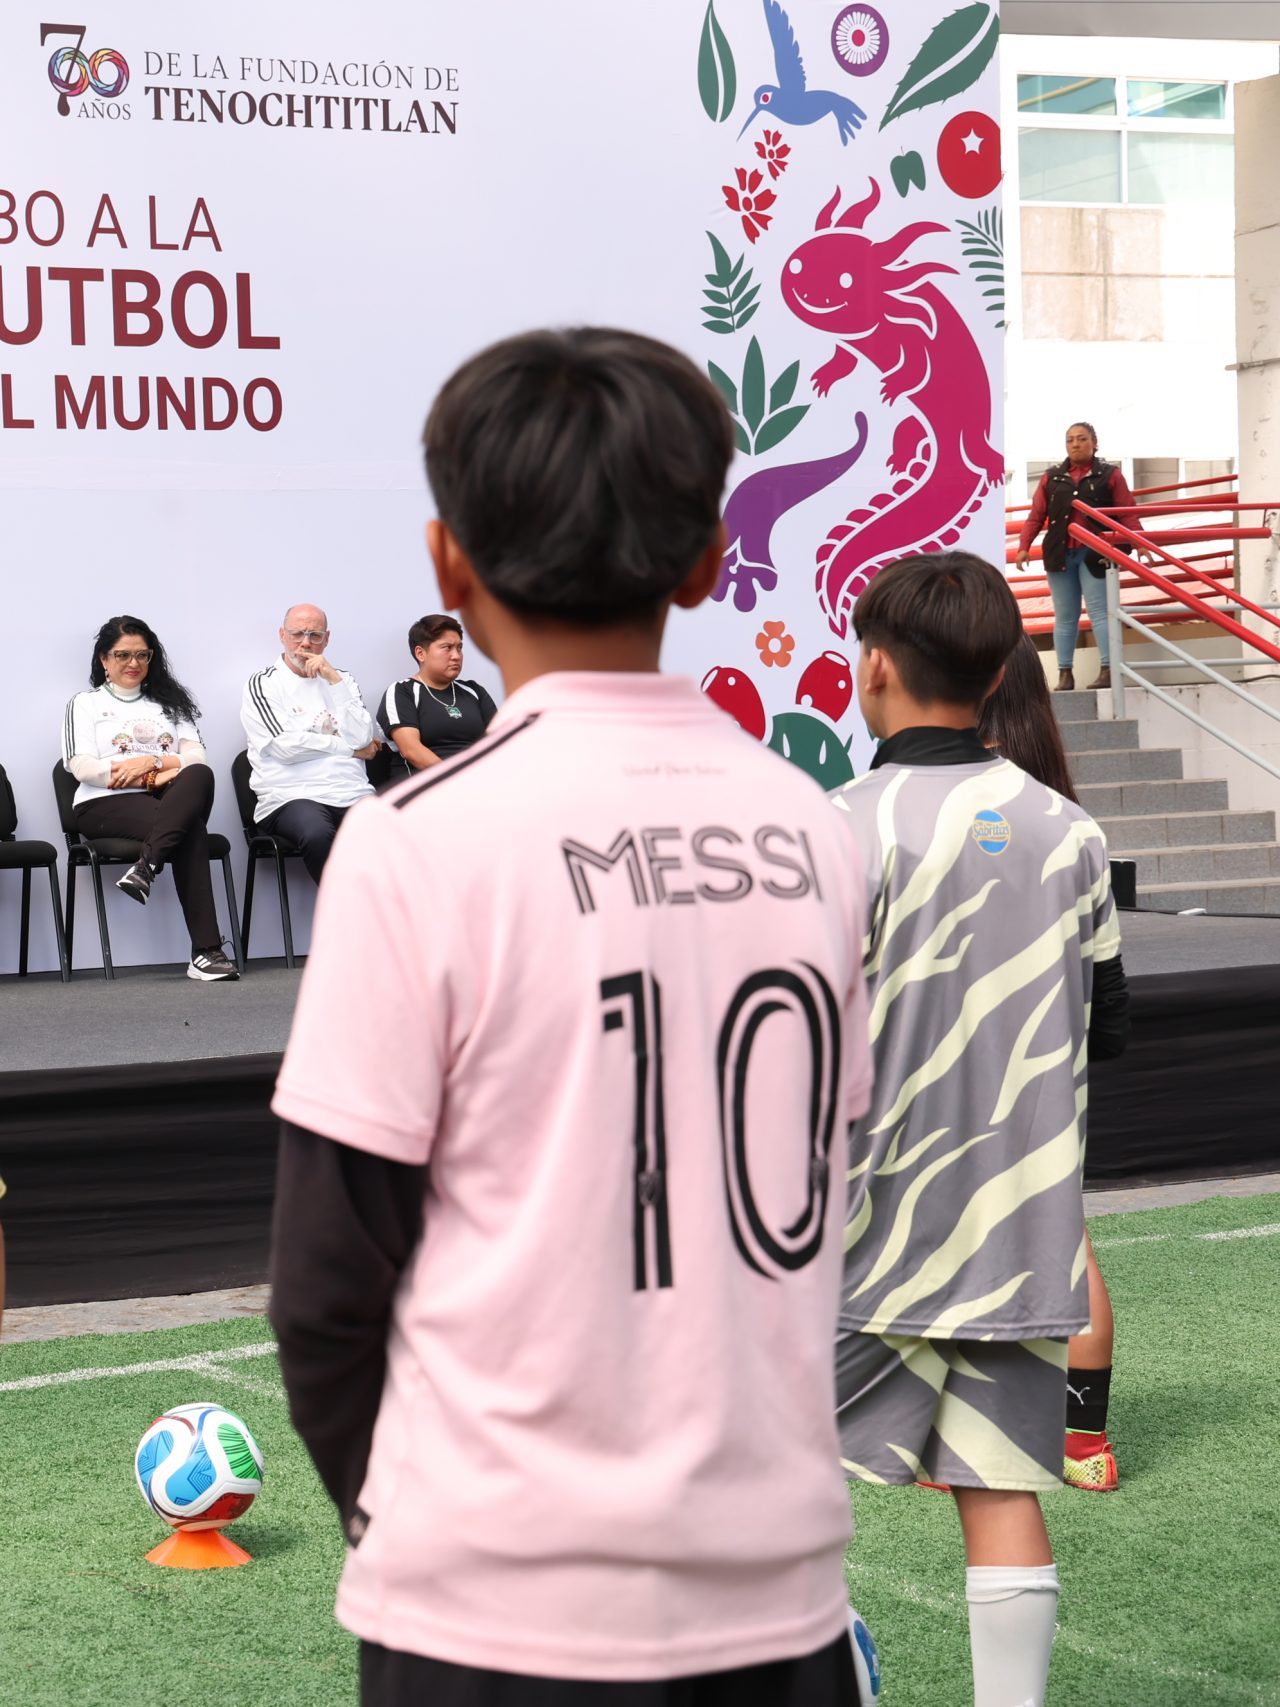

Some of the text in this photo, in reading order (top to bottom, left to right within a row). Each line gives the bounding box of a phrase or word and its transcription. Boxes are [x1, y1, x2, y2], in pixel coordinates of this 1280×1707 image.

[143, 51, 460, 92] DE LA FUNDACIÓN DE
[76, 98, 132, 121] AÑOS
[144, 86, 459, 135] TENOCHTITLAN
[86, 193, 128, 250] A
[148, 194, 223, 253] LA
[54, 374, 283, 433] MUNDO
[560, 825, 824, 915] MESSI
[600, 958, 842, 1293] 10
